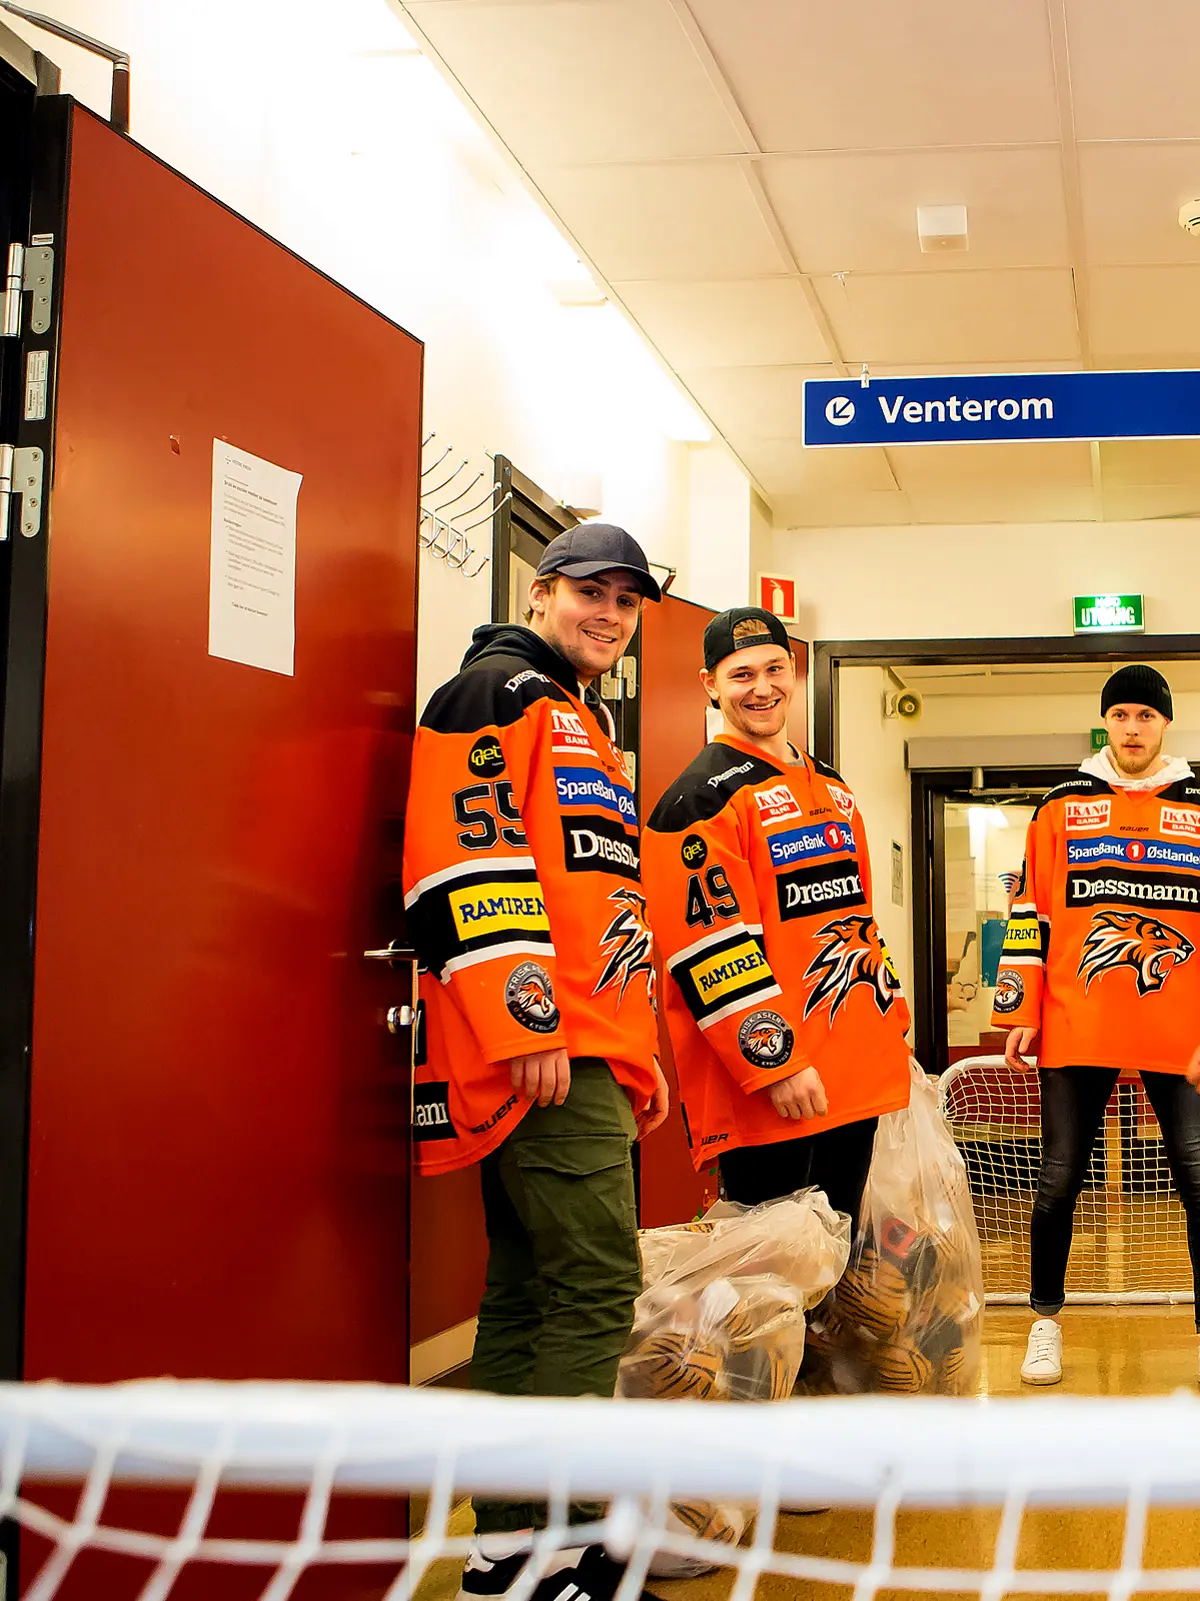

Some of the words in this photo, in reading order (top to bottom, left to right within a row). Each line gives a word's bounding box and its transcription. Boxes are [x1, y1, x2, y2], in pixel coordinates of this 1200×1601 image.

[878, 395, 1054, 424] Venterom
[452, 781, 530, 851] 55
[1067, 804, 1109, 816] IKANO
[1076, 817, 1101, 825] BANK
[1171, 823, 1197, 833] BANK
[1068, 843, 1125, 858] SpareBank
[685, 864, 740, 928] 49
[1071, 879, 1199, 903] Dressmann
